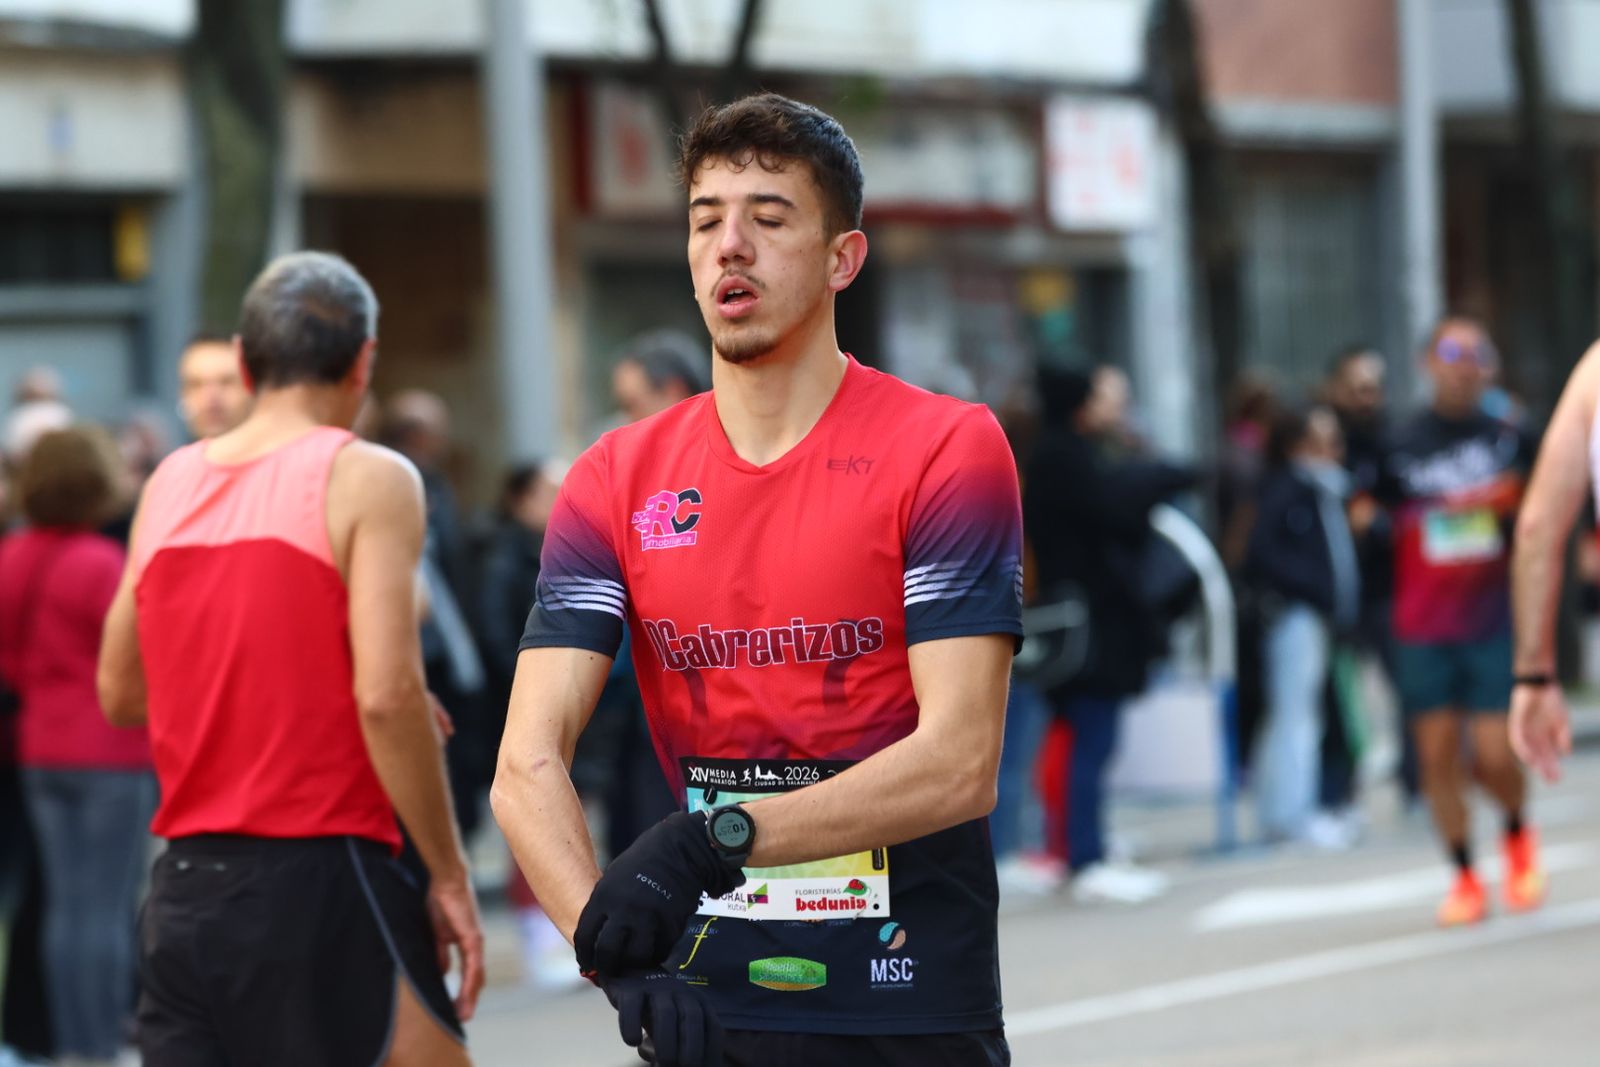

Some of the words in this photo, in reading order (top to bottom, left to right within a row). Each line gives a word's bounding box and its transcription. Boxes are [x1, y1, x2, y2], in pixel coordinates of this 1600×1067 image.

[688, 766, 709, 782] XIV
[709, 769, 736, 779] MEDIA
[784, 766, 820, 781] 2026
[870, 958, 913, 982] MSC
